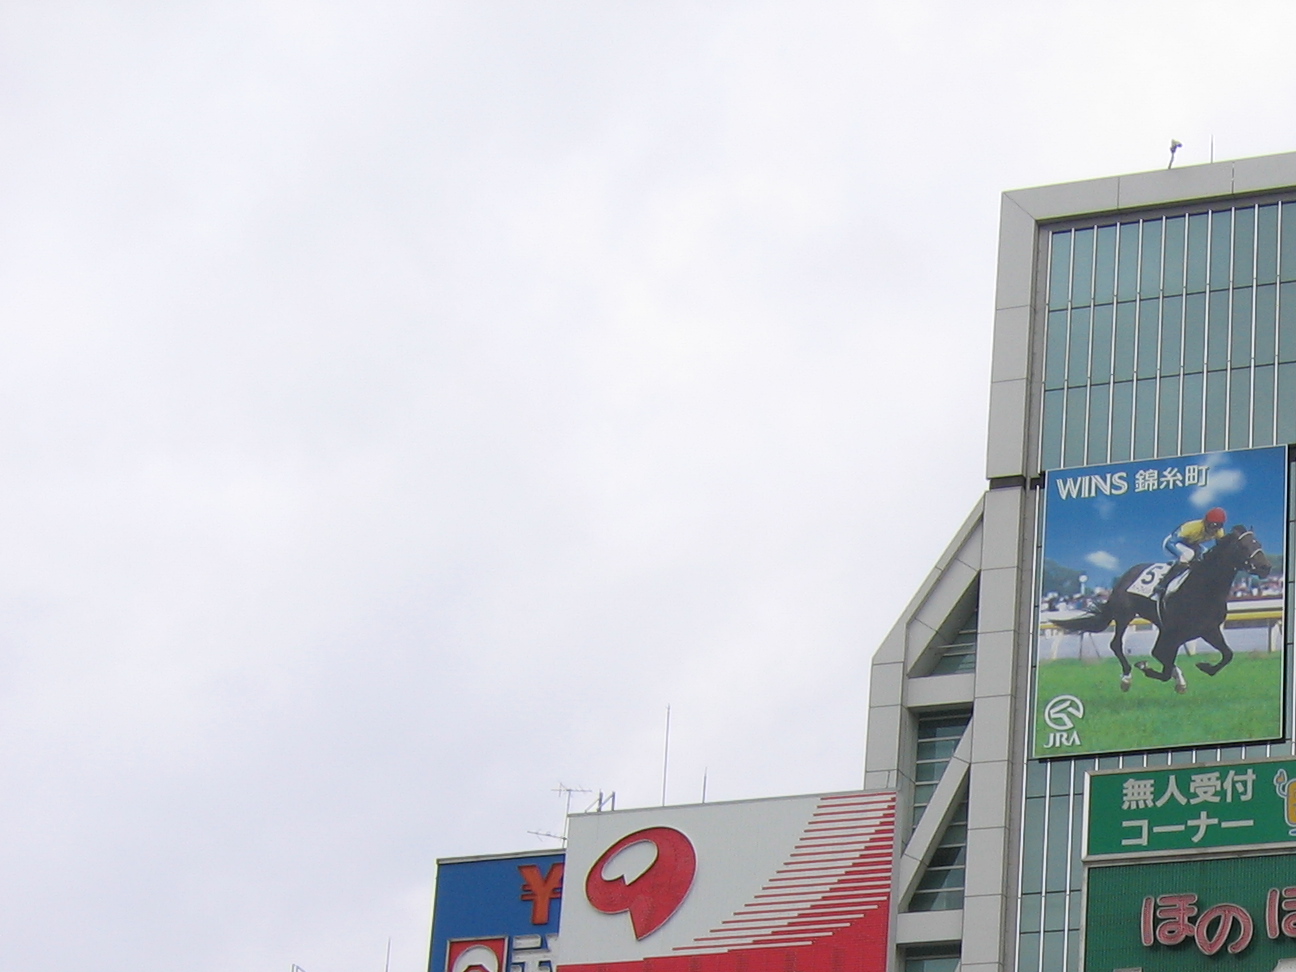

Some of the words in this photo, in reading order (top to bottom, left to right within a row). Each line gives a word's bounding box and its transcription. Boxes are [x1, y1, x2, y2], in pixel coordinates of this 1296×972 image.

[1056, 473, 1129, 500] WINS
[1135, 464, 1210, 493] 錦糸町
[1044, 732, 1082, 749] JRA
[1121, 768, 1256, 809] 無人受付
[1121, 811, 1255, 846] コーナー
